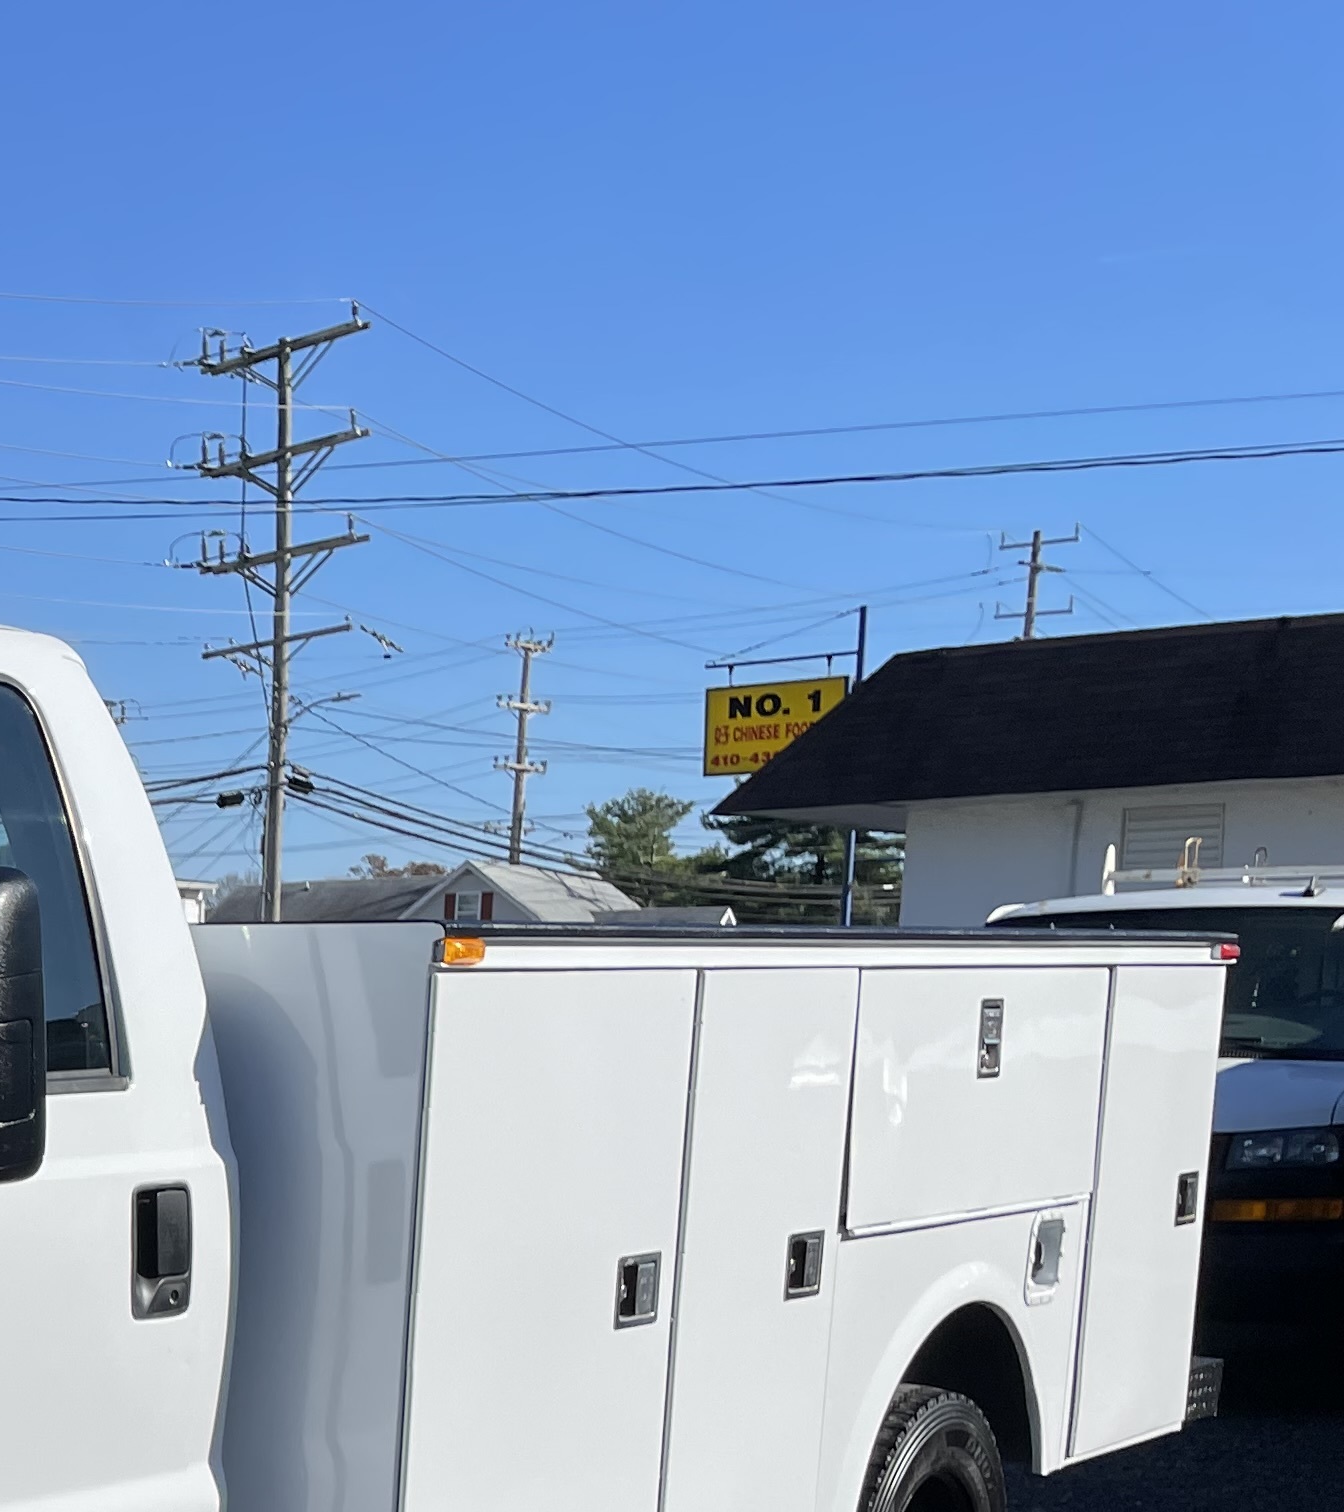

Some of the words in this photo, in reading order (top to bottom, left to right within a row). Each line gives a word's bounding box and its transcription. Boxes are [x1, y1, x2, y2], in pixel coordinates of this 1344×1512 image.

[728, 692, 791, 719] NO.
[807, 689, 822, 712] 1
[733, 723, 781, 742] CHINESE
[785, 721, 817, 739] FOO
